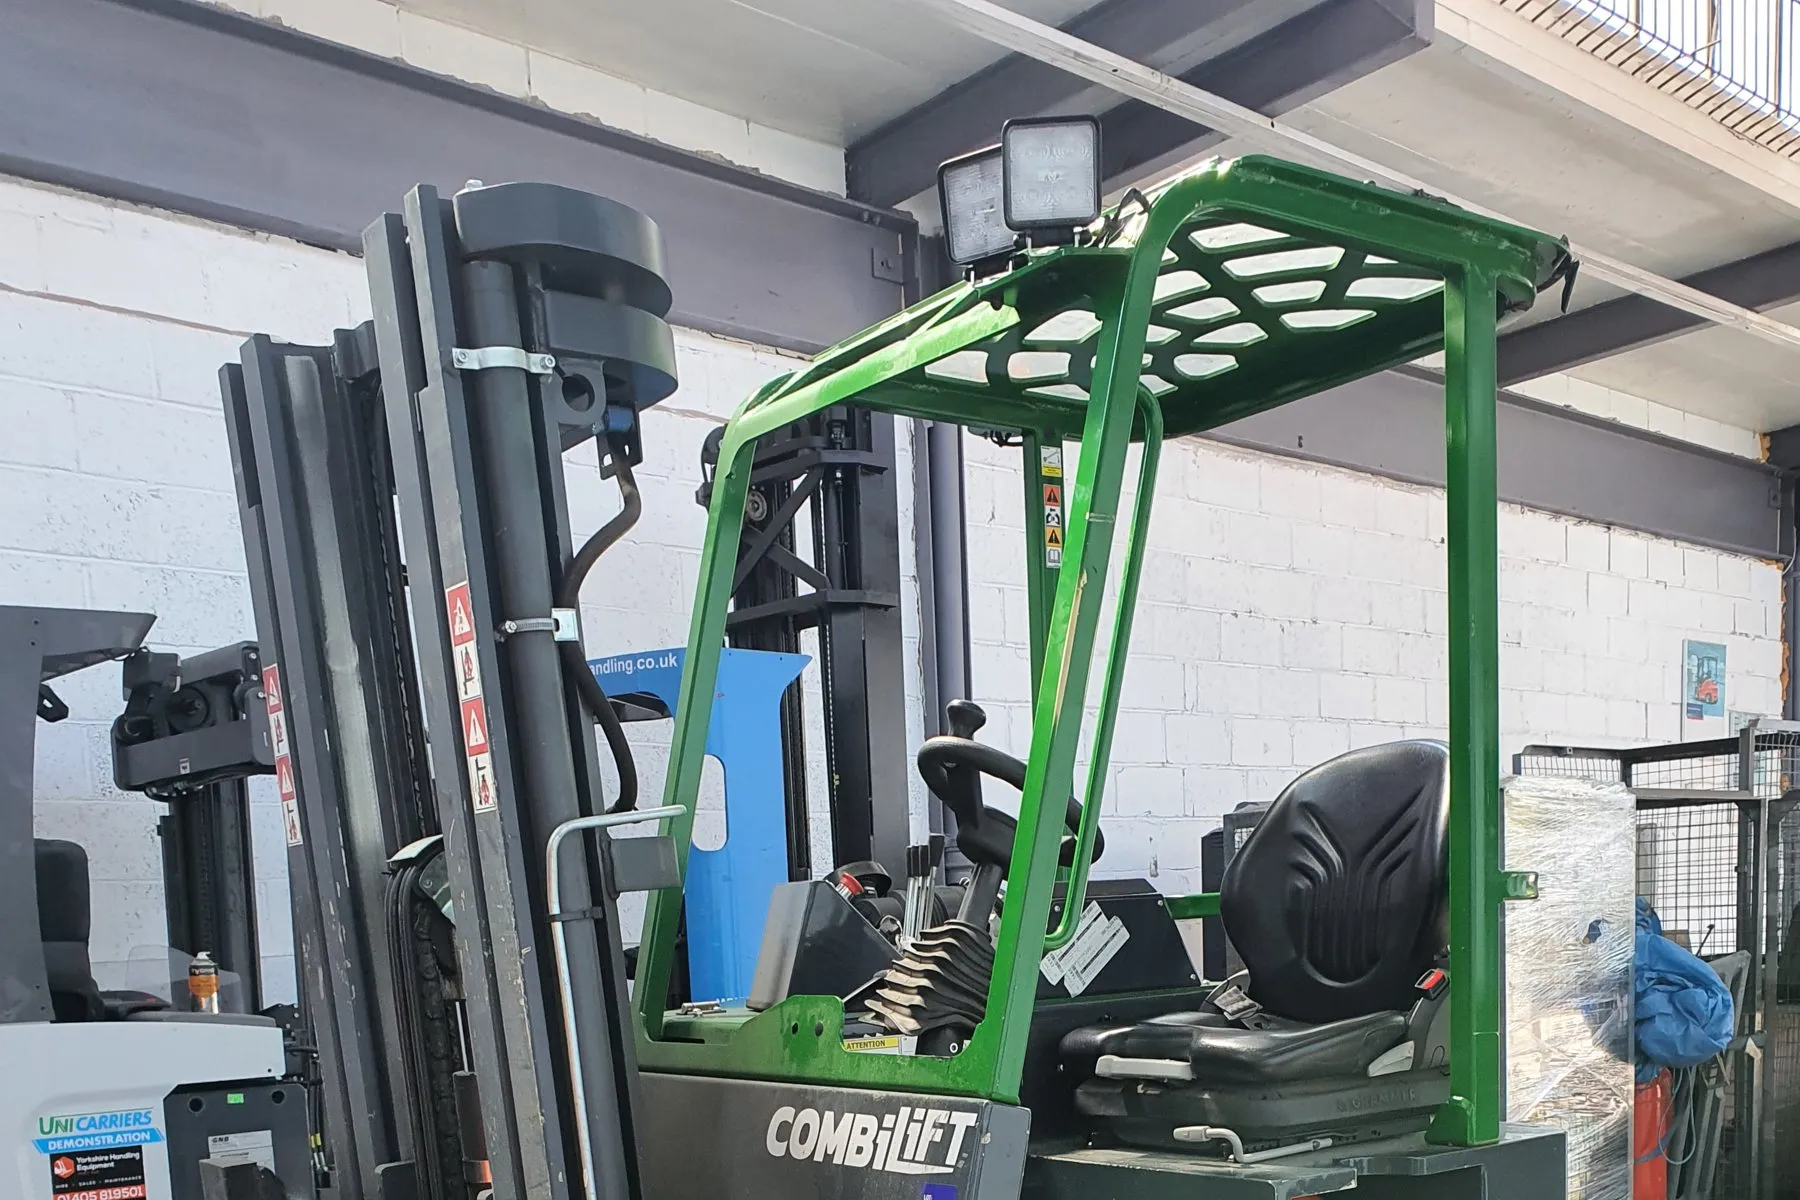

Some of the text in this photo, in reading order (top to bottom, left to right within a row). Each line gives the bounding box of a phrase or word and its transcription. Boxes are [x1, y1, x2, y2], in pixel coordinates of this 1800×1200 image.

[589, 652, 678, 676] andling.co.uk
[846, 1040, 886, 1050] ATTENTION
[48, 1131, 151, 1151] DEMONSTRATION
[76, 1152, 140, 1164] Yorkshire Handling
[77, 1161, 115, 1171] Equipment
[99, 1185, 144, 1200] 819501
